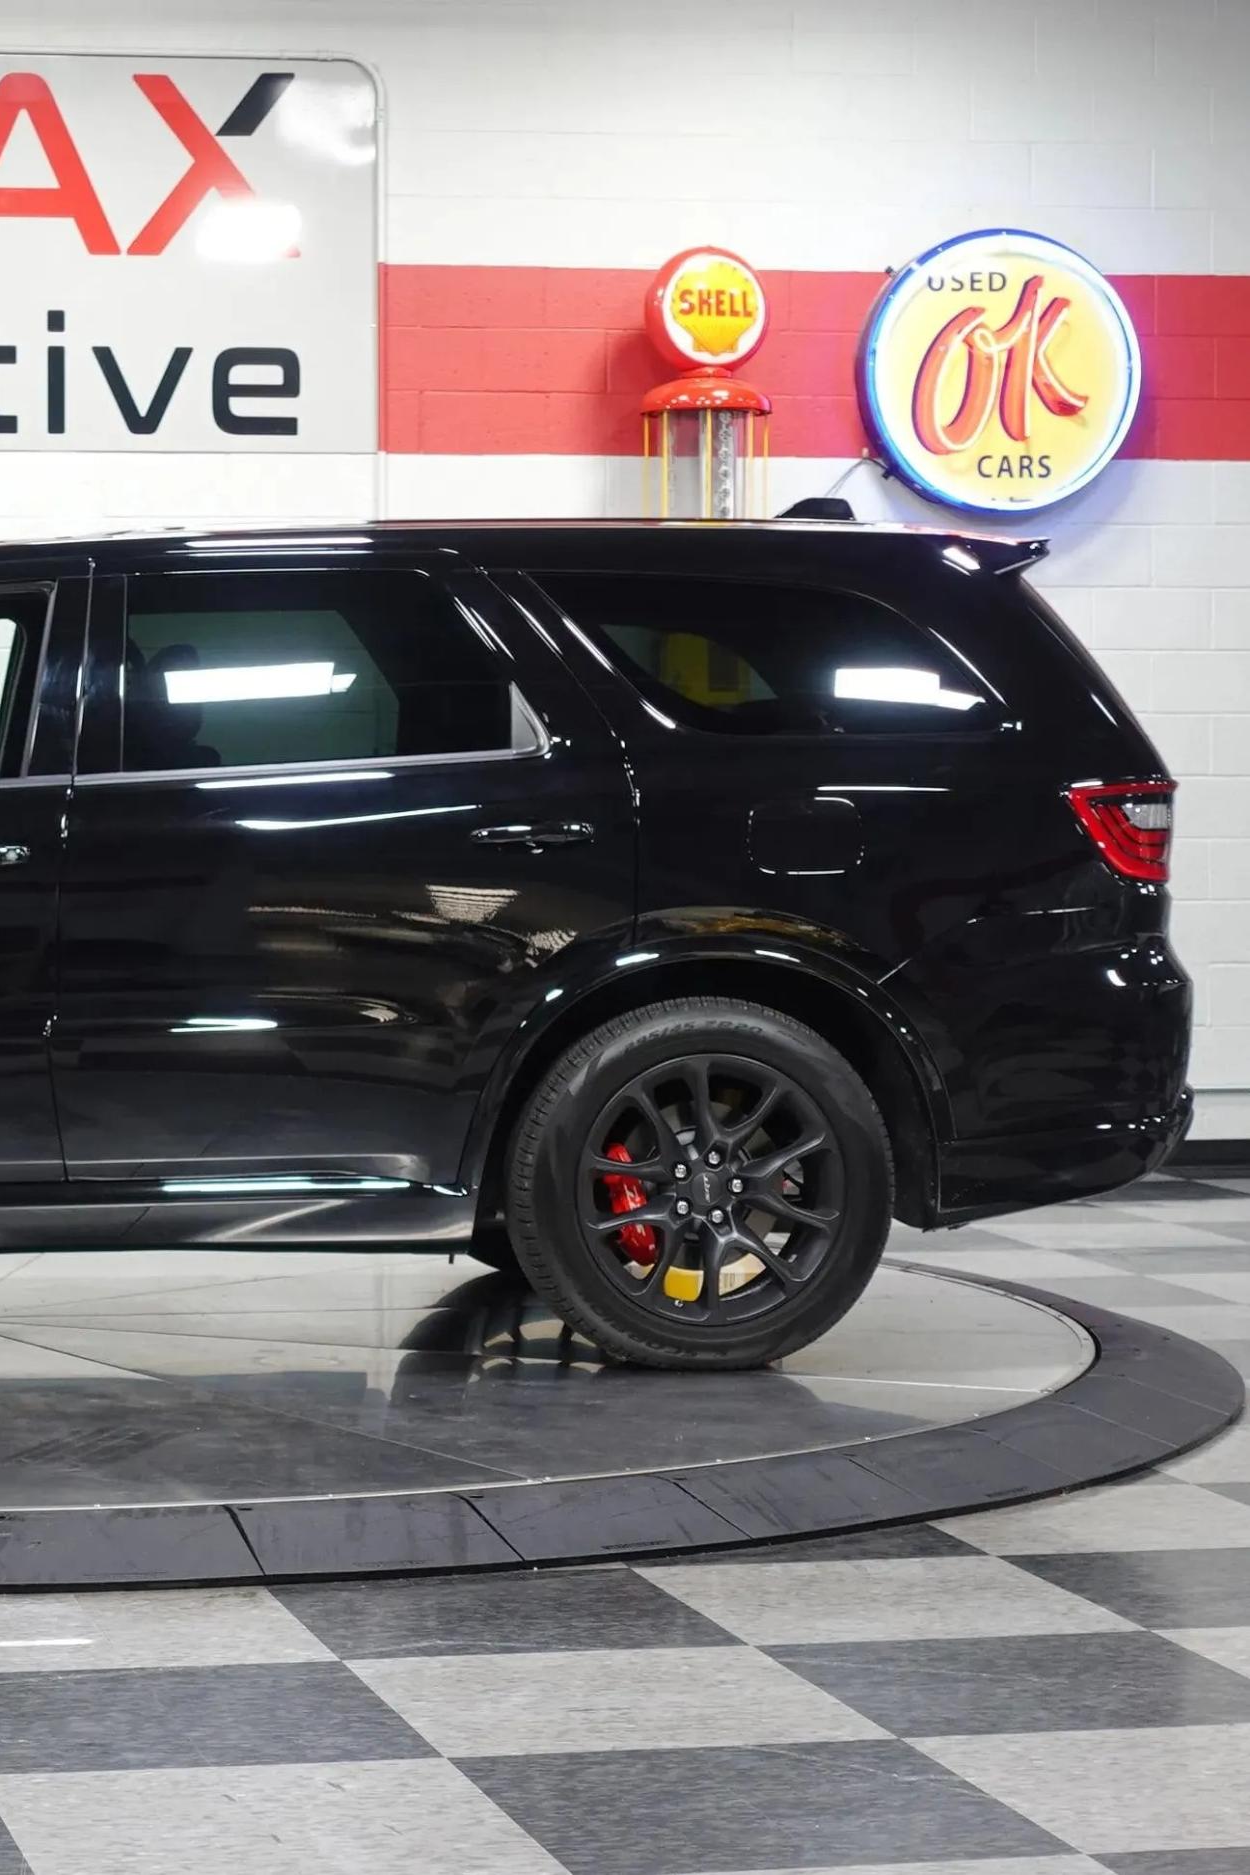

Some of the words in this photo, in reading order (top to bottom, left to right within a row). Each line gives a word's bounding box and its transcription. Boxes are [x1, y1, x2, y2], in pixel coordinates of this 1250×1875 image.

[927, 271, 1007, 292] USED
[678, 288, 753, 318] SHELL
[911, 275, 1089, 455] OK
[977, 454, 1053, 479] CARS
